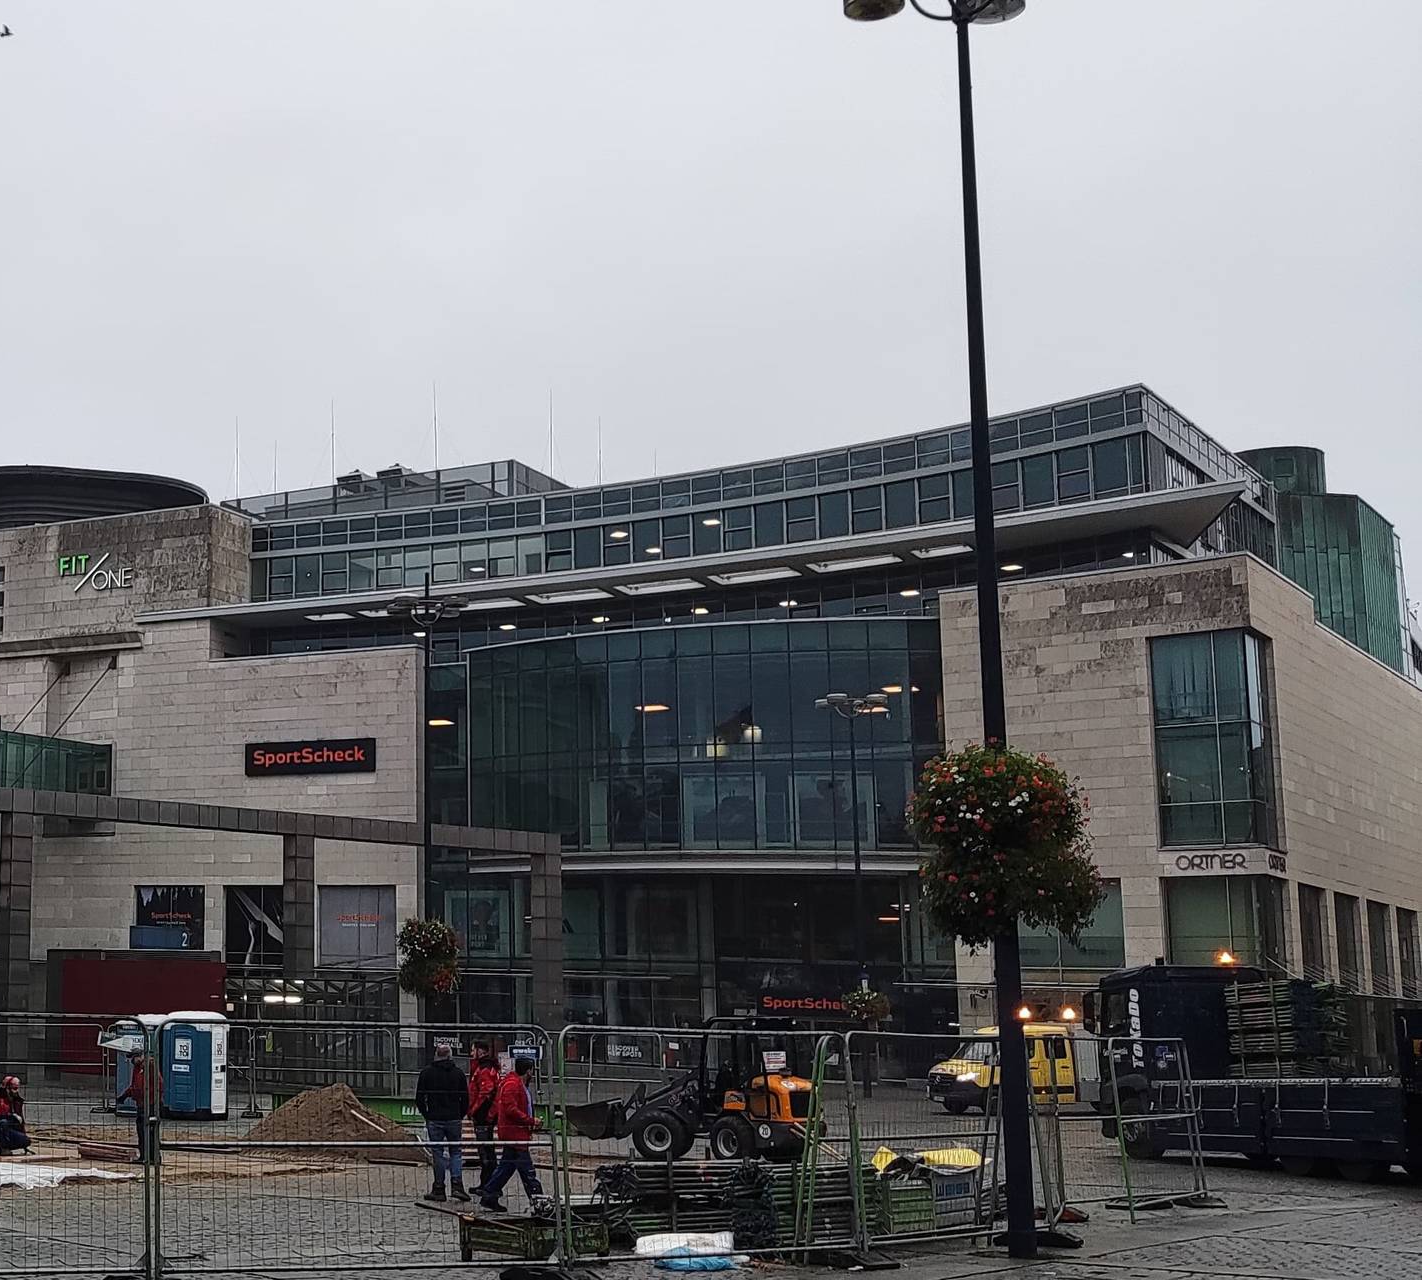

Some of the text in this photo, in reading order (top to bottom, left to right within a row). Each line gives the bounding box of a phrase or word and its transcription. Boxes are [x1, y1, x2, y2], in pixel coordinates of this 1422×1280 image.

[60, 555, 133, 590] FIT ONE
[253, 745, 366, 768] SportScheck
[1176, 853, 1248, 871] ORTNER
[182, 932, 188, 947] 2
